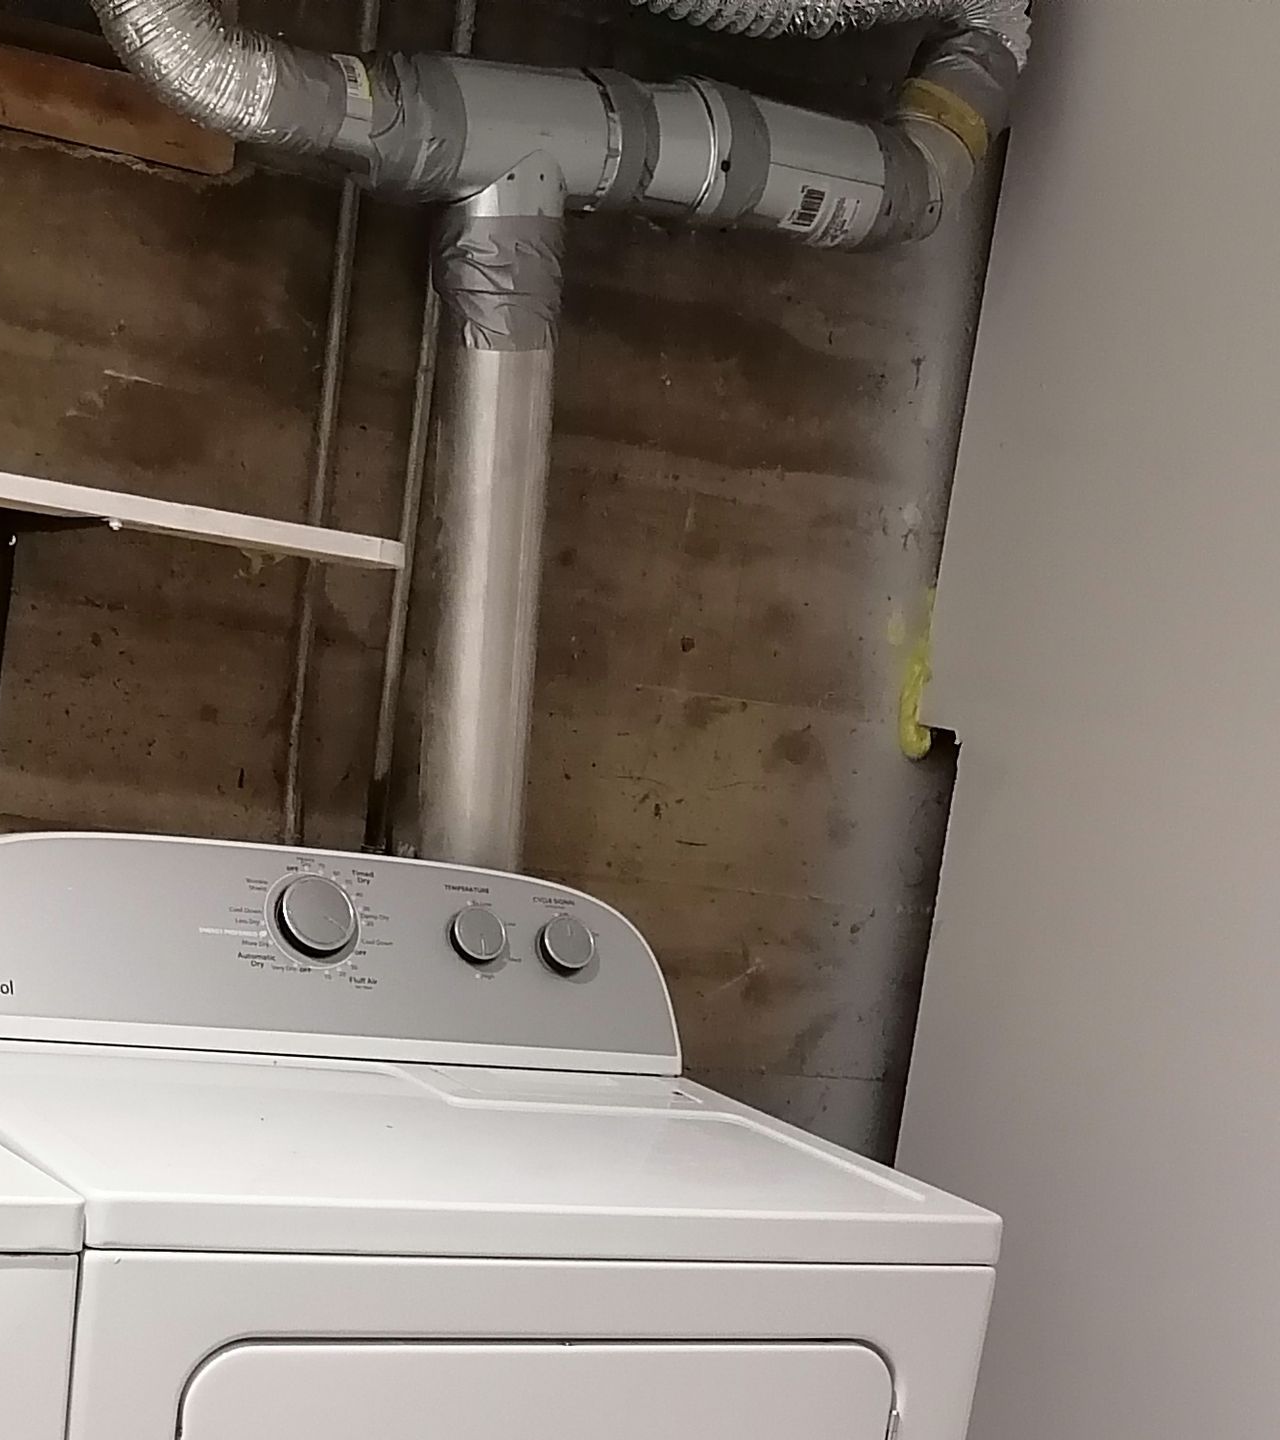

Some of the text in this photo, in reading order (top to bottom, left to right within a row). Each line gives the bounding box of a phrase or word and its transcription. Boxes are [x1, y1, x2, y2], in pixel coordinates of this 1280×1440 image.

[352, 869, 375, 878] Timed
[357, 877, 371, 885] Dry
[444, 884, 490, 894] TEMPERATURE
[532, 896, 552, 904] CYCLE
[237, 951, 276, 961] Automatic
[250, 959, 265, 968] Dry
[349, 976, 378, 985] Fluff Air
